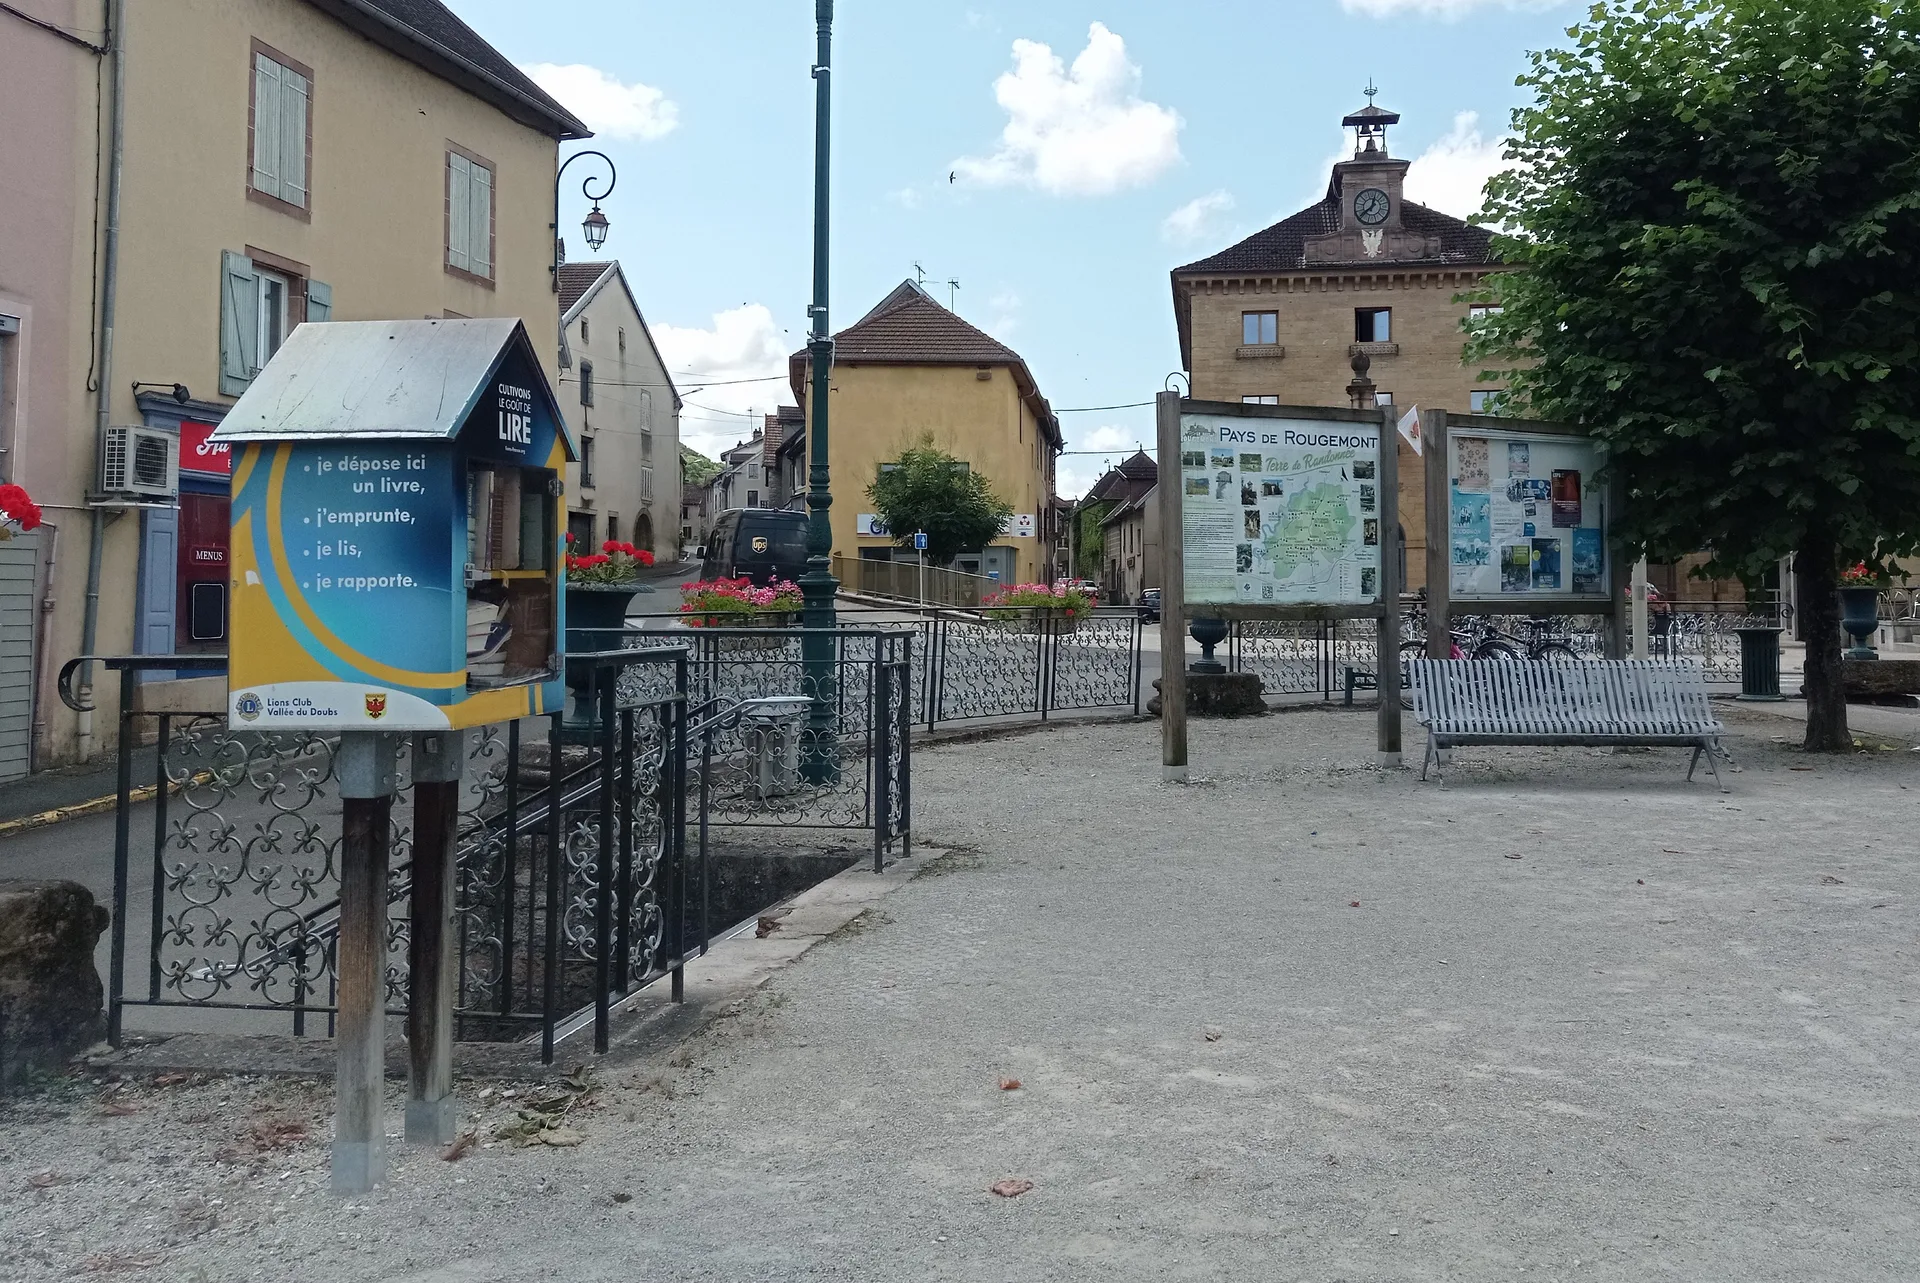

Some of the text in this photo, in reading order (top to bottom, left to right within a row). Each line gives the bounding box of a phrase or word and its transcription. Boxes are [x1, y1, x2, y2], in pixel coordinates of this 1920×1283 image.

[498, 383, 531, 400] CULTIVONS
[498, 398, 531, 414] LE GOÛT DE
[498, 411, 531, 444] LIRE
[1219, 427, 1379, 449] PAYS DE ROUGEMONT
[316, 454, 426, 476] je dépose ici
[1264, 448, 1357, 473] Terre de Randonnée
[353, 478, 426, 496] un livre,
[316, 509, 416, 528] j'emprunte,
[316, 541, 362, 560] je lis,
[753, 541, 767, 551] ups
[195, 550, 223, 561] MENUS
[316, 574, 418, 592] je rapporte.
[246, 701, 254, 712] L
[267, 698, 312, 707] Lions Club
[267, 707, 338, 717] Vallée du Doubs
